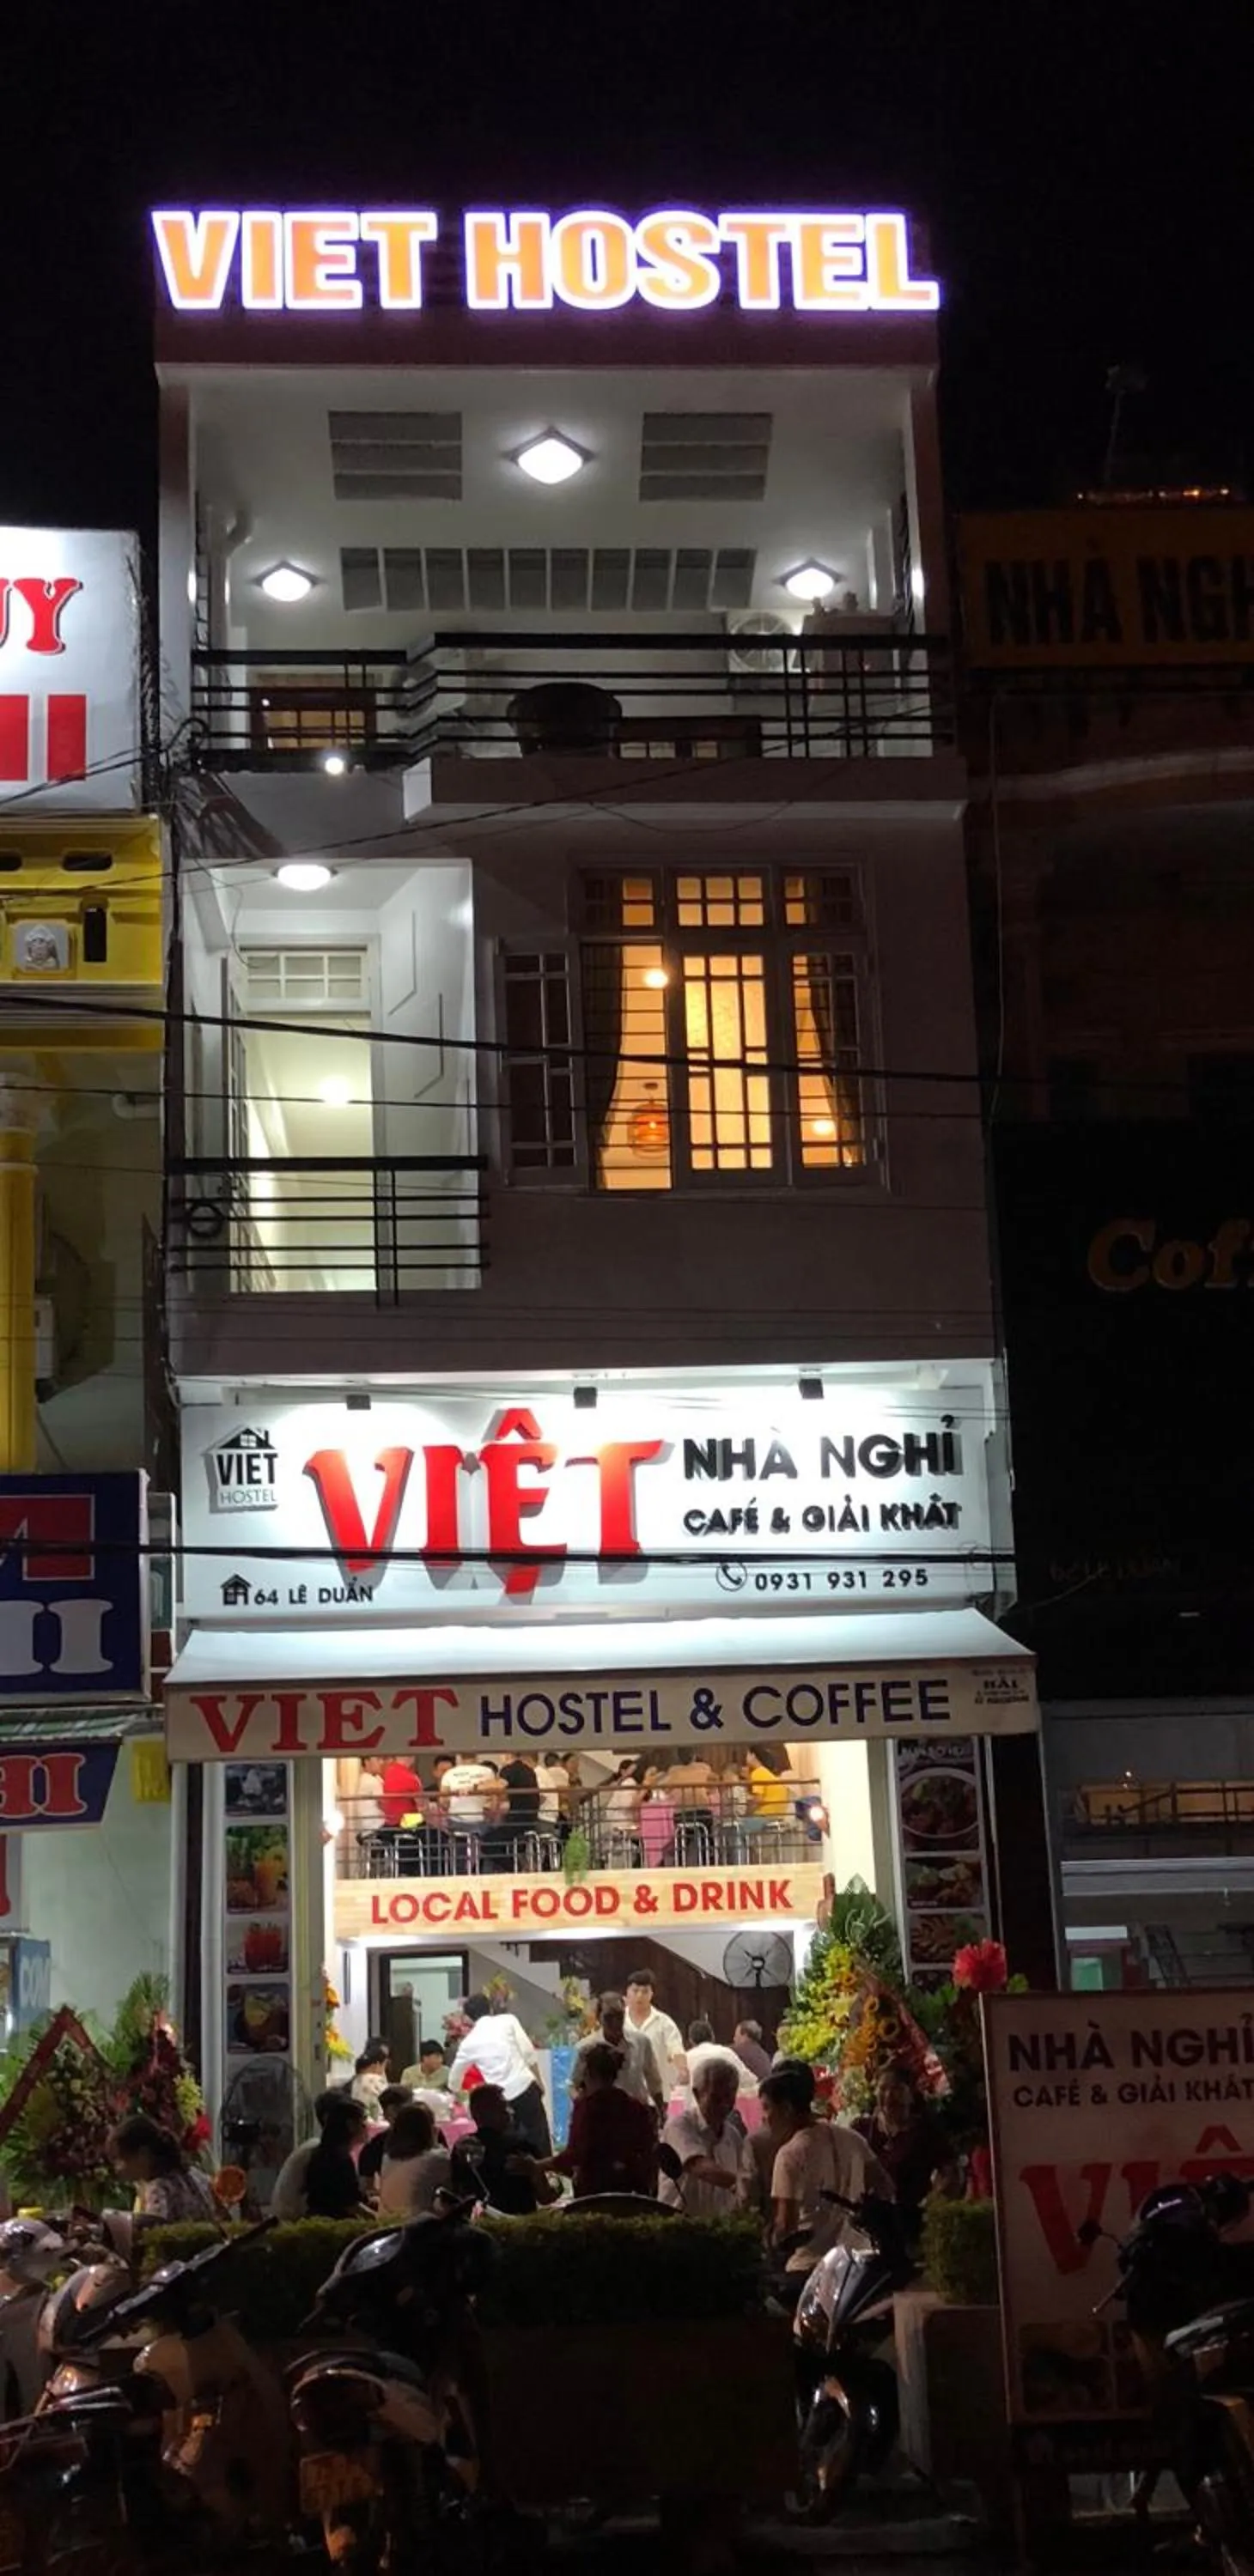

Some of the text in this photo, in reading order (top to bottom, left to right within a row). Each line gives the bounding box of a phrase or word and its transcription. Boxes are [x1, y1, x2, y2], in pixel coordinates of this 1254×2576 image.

[152, 210, 940, 311] VIET HOSTEL
[0, 578, 83, 655] Y
[1087, 1216, 1254, 1291] Cof
[216, 1453, 278, 1485] VIET
[683, 1414, 963, 1479] NHÀ NGHỈ
[220, 1488, 277, 1504] HOSTEL
[303, 1407, 668, 1595] VIỆT
[683, 1498, 759, 1535] CAFÉ
[770, 1507, 791, 1534] &
[801, 1494, 870, 1533] GIẢI
[254, 1589, 278, 1605] 64
[289, 1584, 307, 1604] LÊ
[755, 1568, 928, 1591] 0931 931 295
[190, 1680, 951, 1753] VIET HOSTEL & COFFEE
[372, 1879, 794, 1924] LOCAL FOOD & DRINK
[1007, 2012, 1254, 2071] NHÀ NGHỈ
[1014, 2079, 1081, 2107] CAFÉ
[1091, 2084, 1107, 2105] &
[1118, 2075, 1175, 2104] GIẢI
